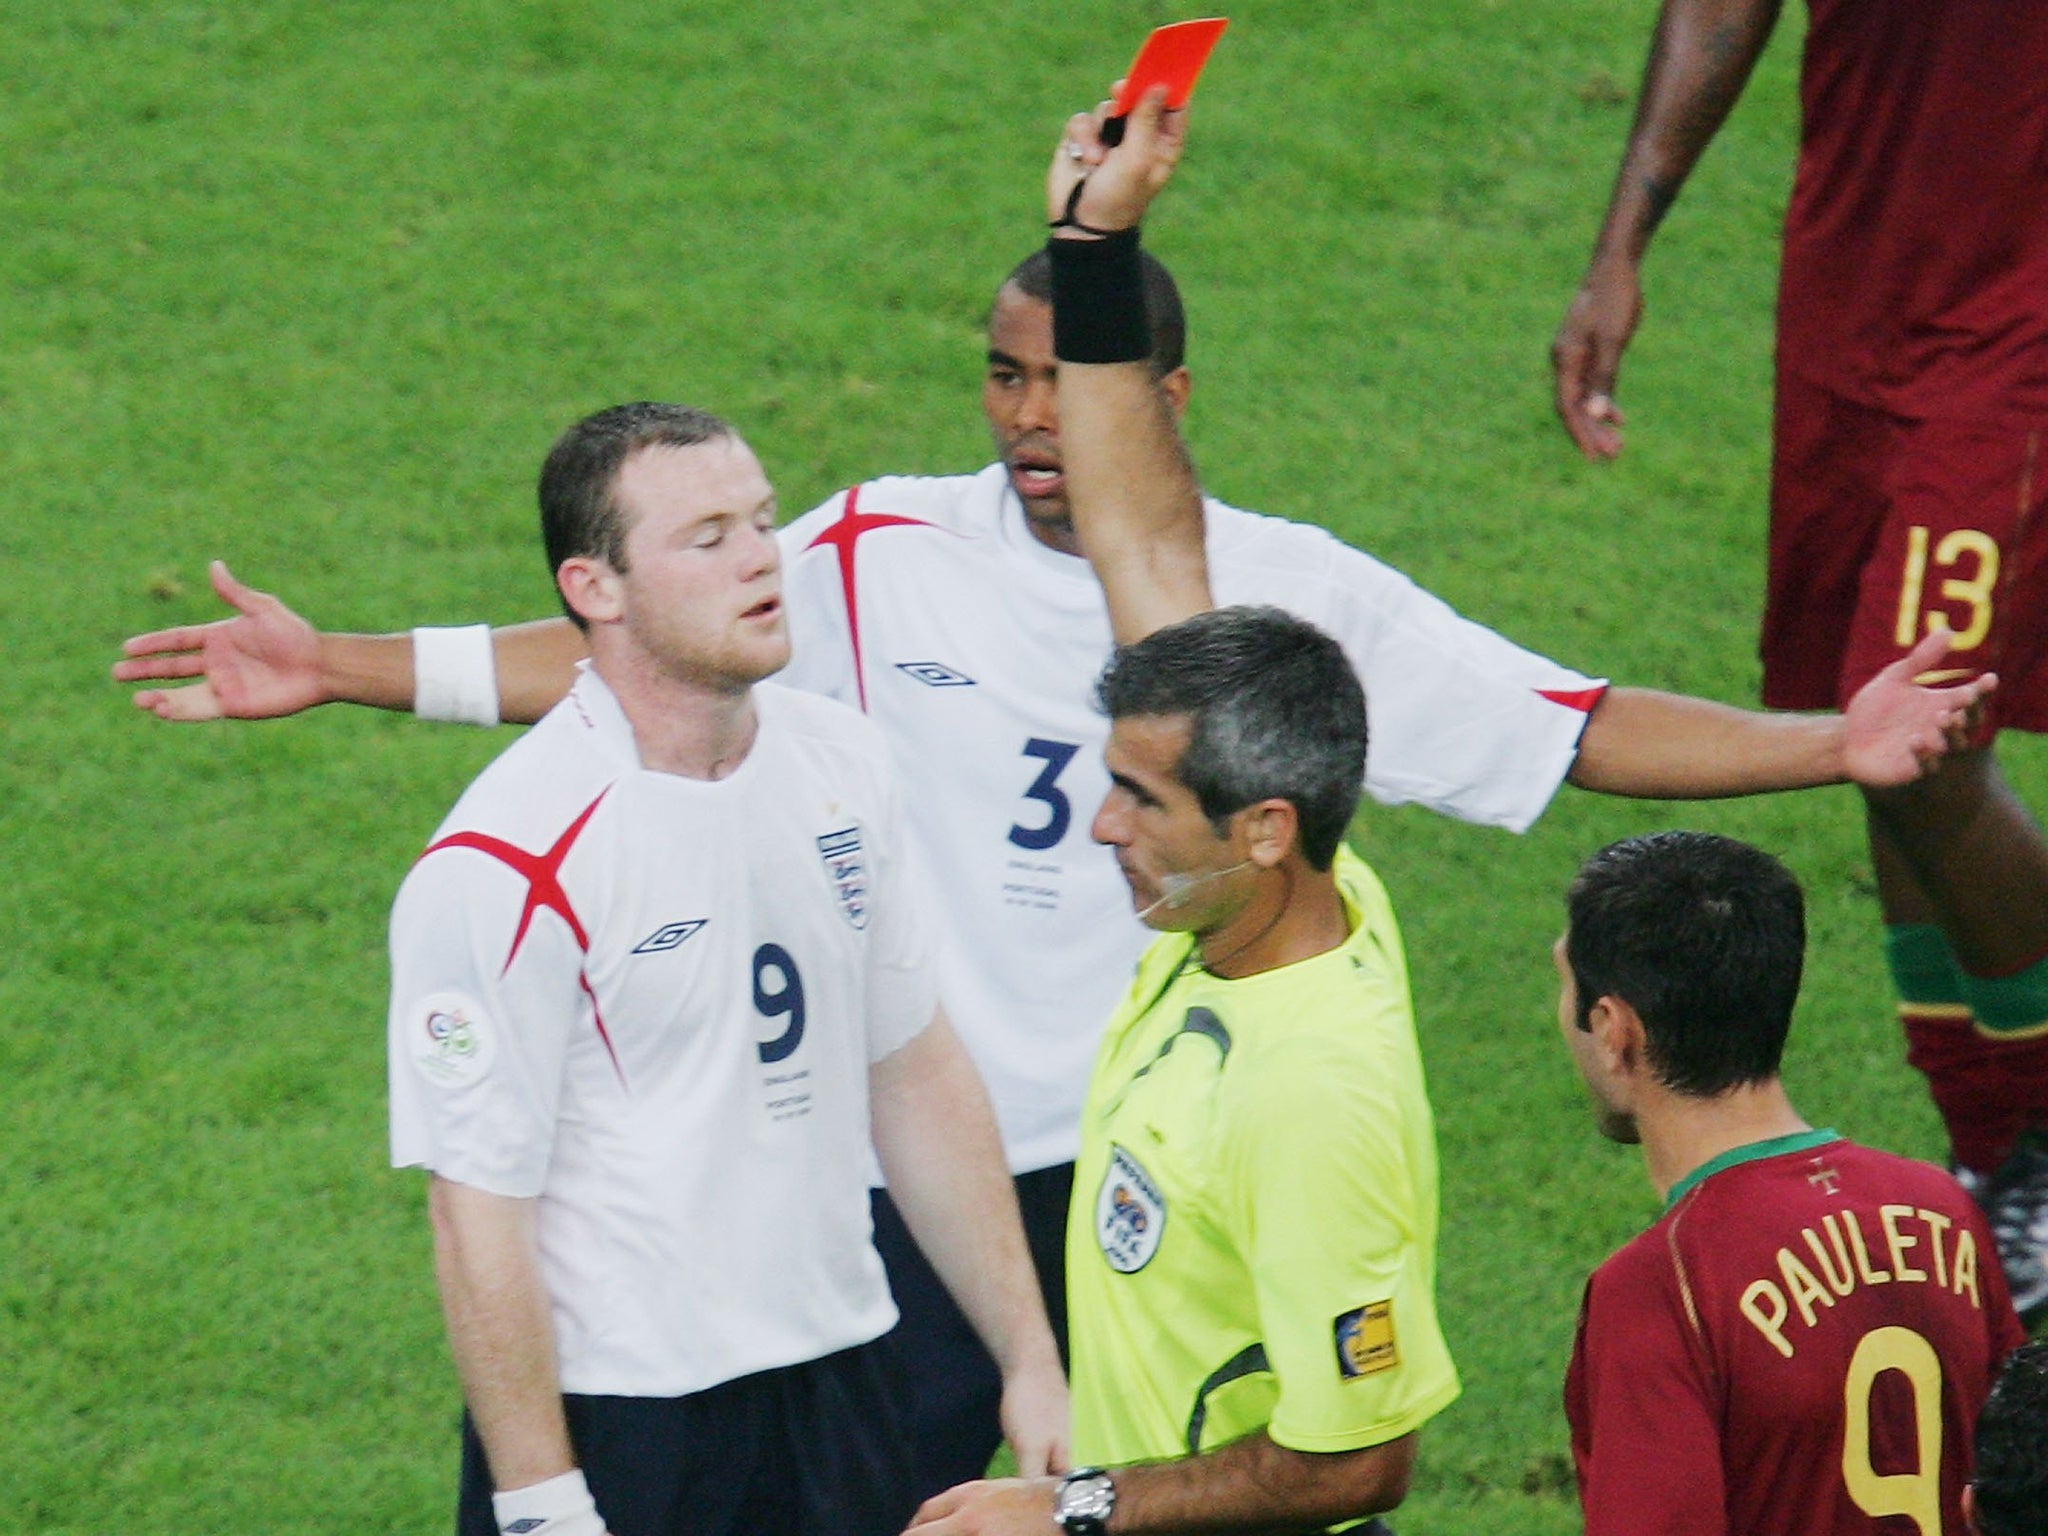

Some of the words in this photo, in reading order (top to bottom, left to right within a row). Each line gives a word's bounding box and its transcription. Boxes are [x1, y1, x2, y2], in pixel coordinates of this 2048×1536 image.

[1896, 525, 1999, 651] 13
[1007, 737, 1082, 850] 3
[753, 943, 805, 1063] 9
[1739, 1205, 1980, 1358] PAULETA
[1842, 1326, 1943, 1536] 9
